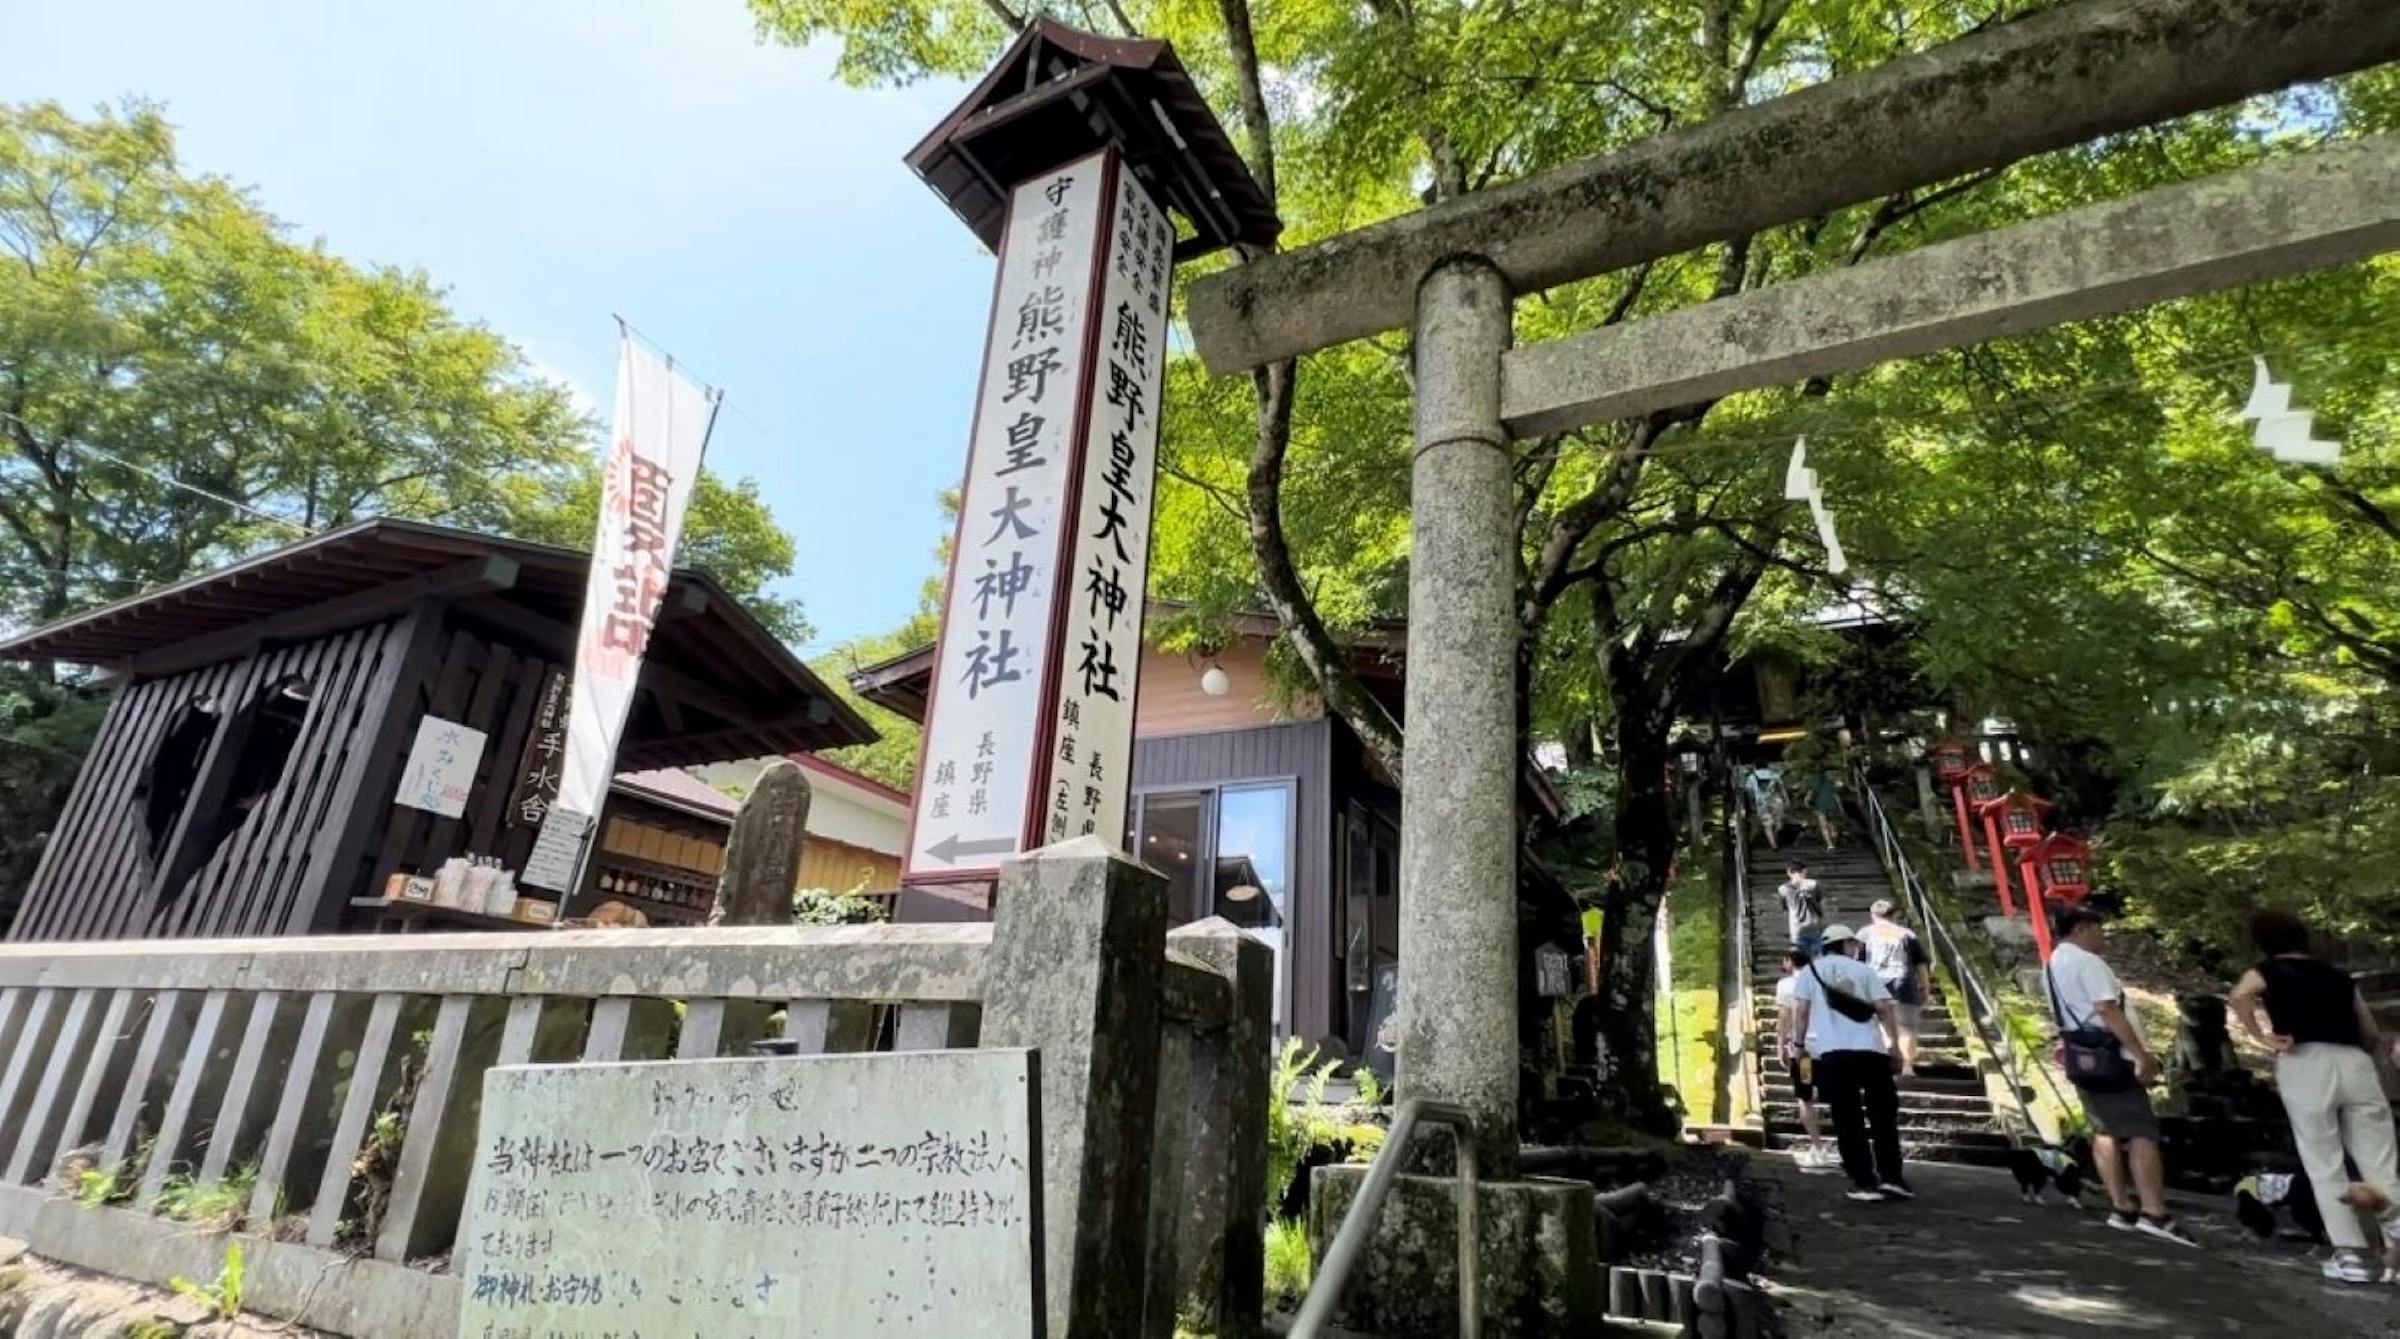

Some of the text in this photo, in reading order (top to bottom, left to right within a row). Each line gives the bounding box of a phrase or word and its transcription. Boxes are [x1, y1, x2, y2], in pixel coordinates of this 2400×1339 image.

[1031, 176, 1075, 280] 守護神
[960, 285, 1066, 701] 熊野皇大神社
[1077, 298, 1147, 704] 熊野皇大神社
[521, 731, 563, 823] 手水舎
[929, 760, 957, 820] 鎮座
[966, 730, 998, 816] 長野県
